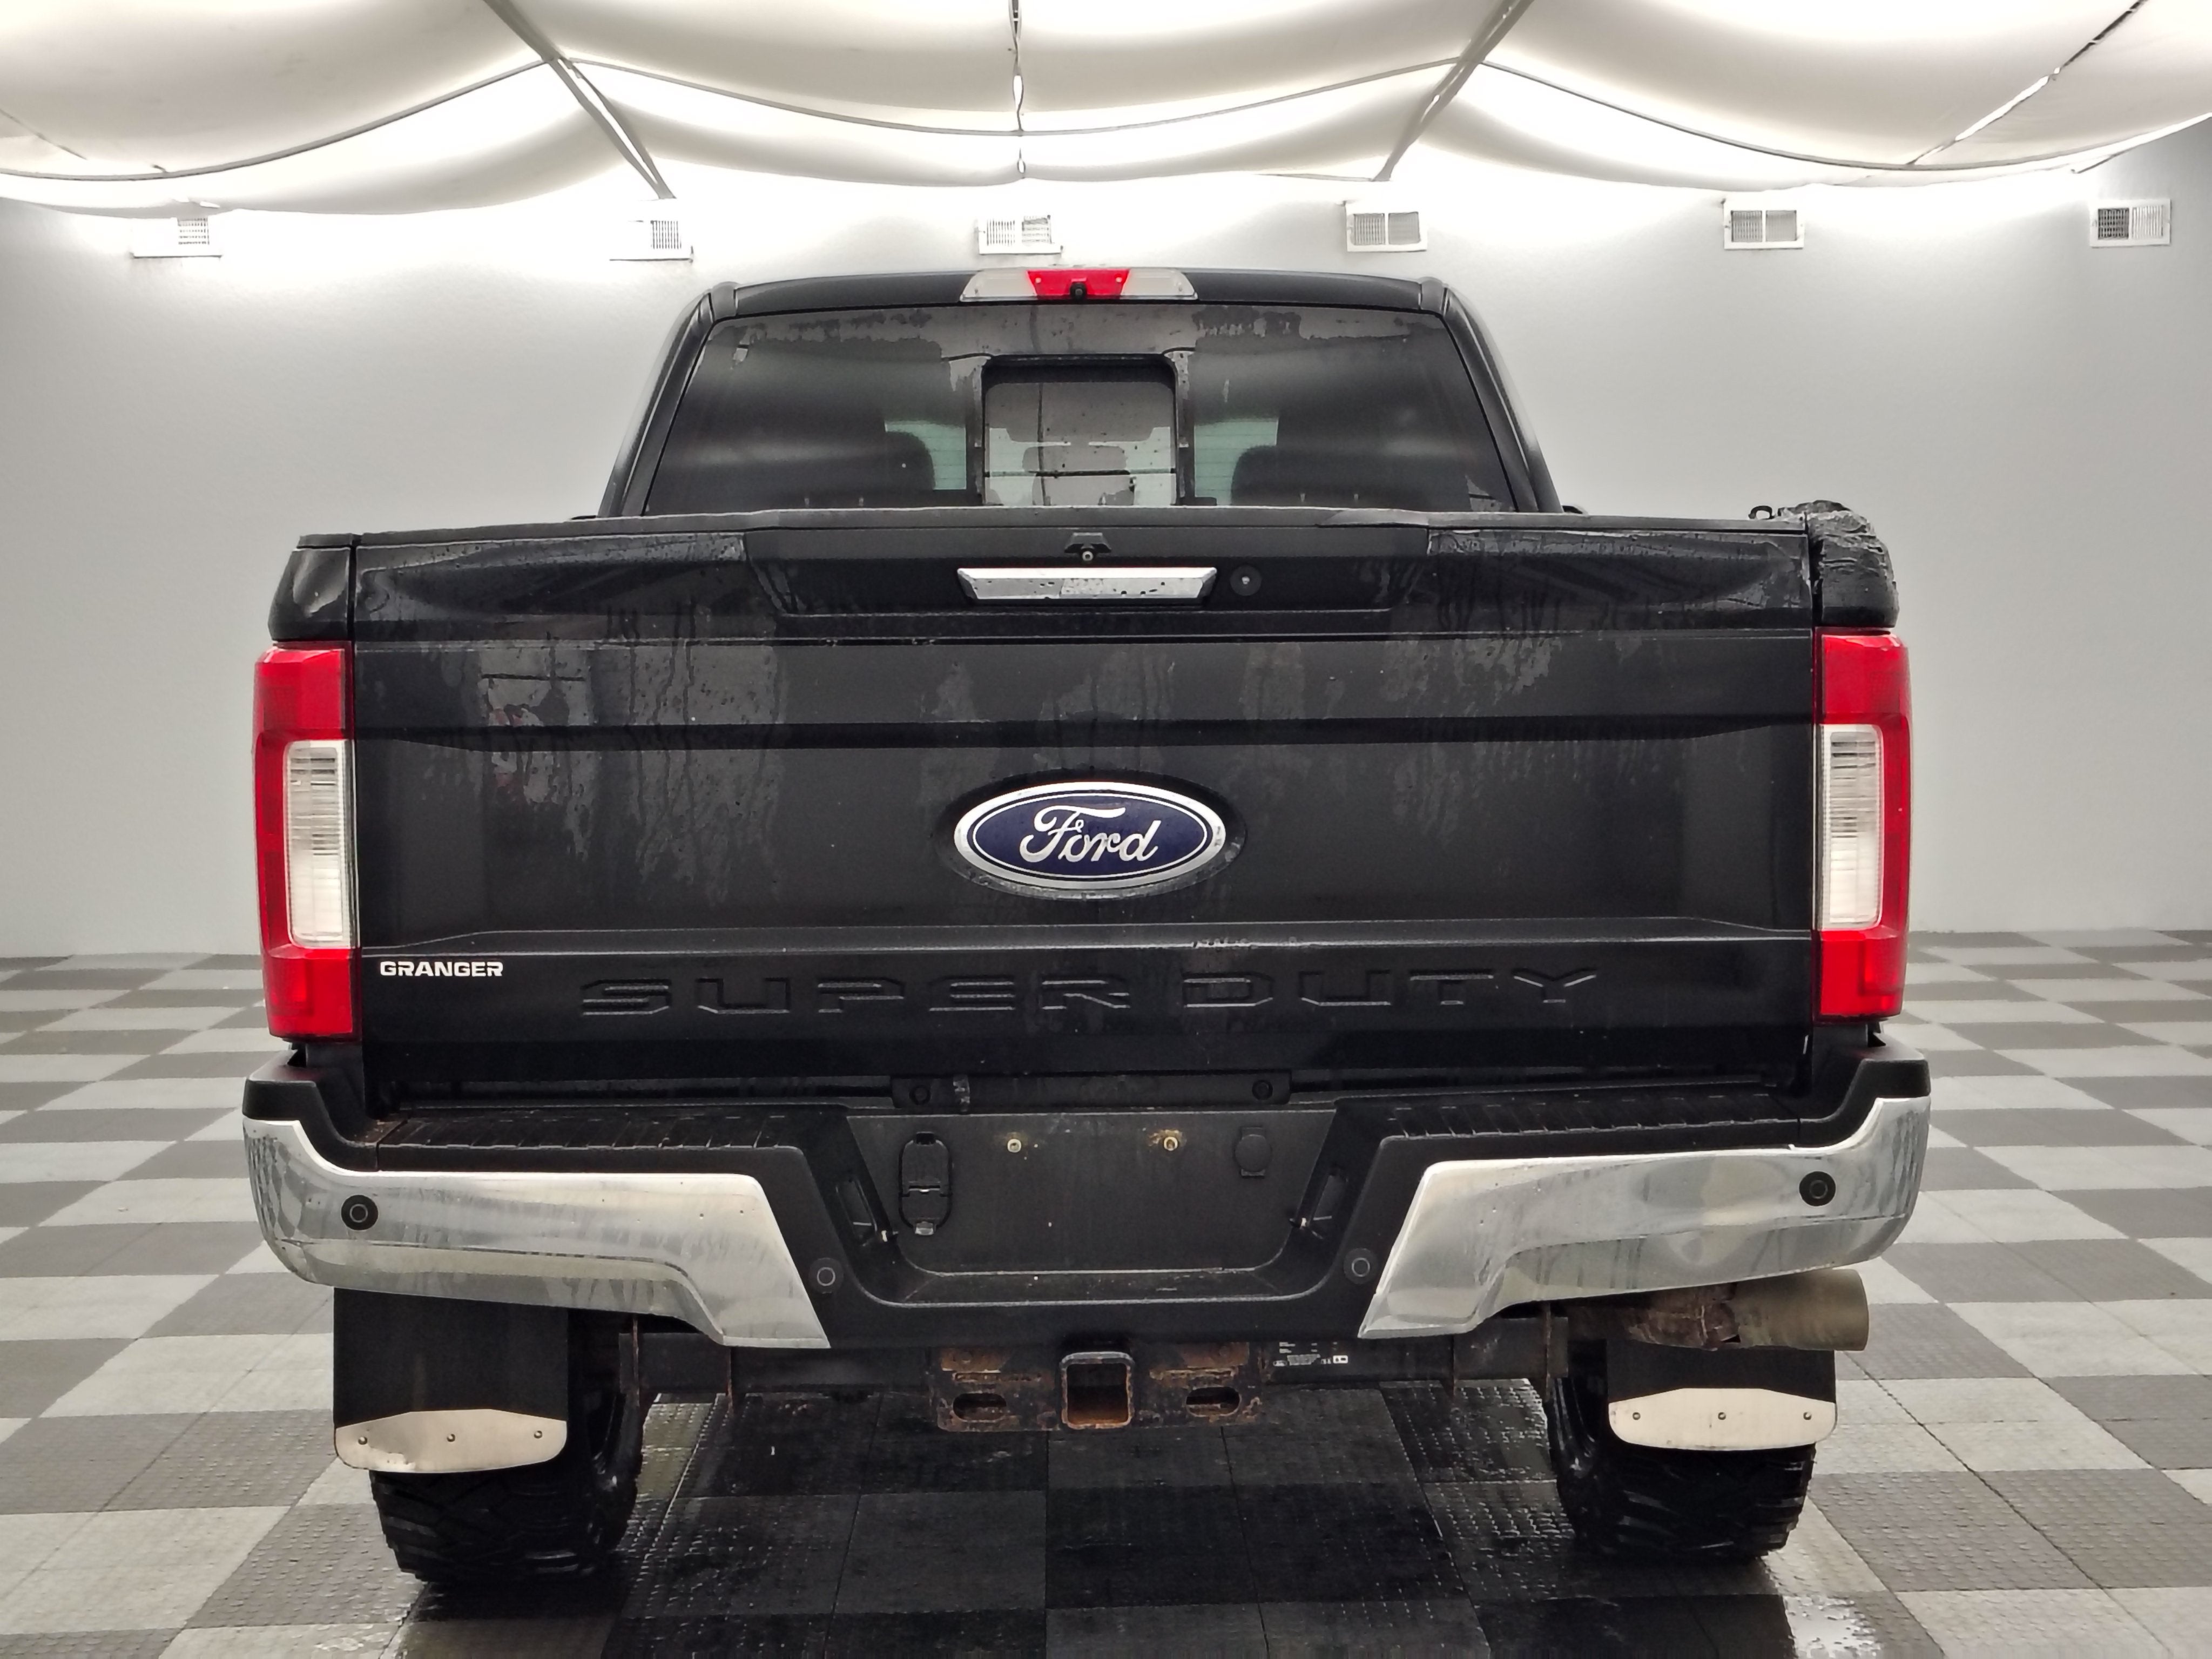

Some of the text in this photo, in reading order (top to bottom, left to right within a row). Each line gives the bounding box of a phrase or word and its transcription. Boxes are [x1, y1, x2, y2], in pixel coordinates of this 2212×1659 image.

[1019, 805, 1162, 863] Ford
[380, 961, 504, 977] GRANGER
[580, 968, 1597, 1016] SUPER DUTY
